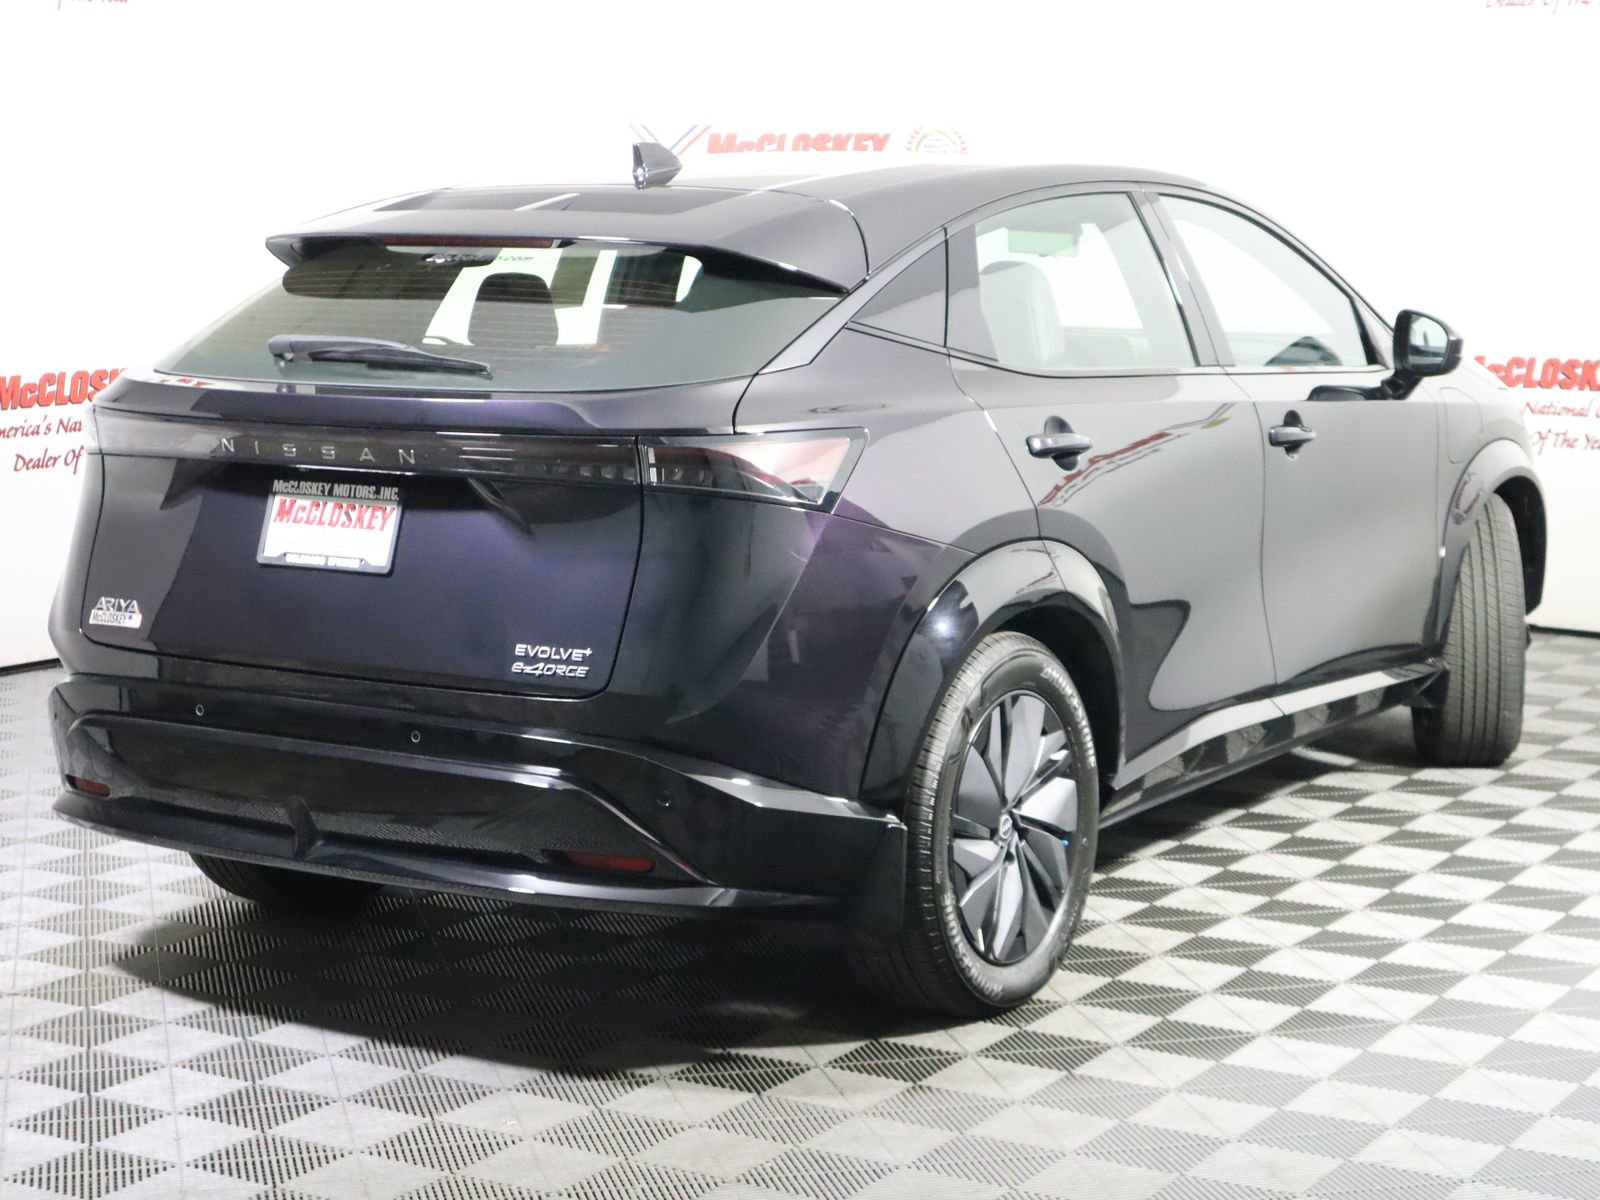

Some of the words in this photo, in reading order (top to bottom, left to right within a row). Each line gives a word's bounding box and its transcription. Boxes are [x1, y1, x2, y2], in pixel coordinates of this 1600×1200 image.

[13, 447, 61, 472] Dealer
[64, 444, 84, 475] Of
[220, 437, 416, 465] NISSAN
[273, 497, 396, 532] McCLOSKEY
[93, 596, 140, 613] ARIYA
[514, 643, 592, 662] EVOLVE+
